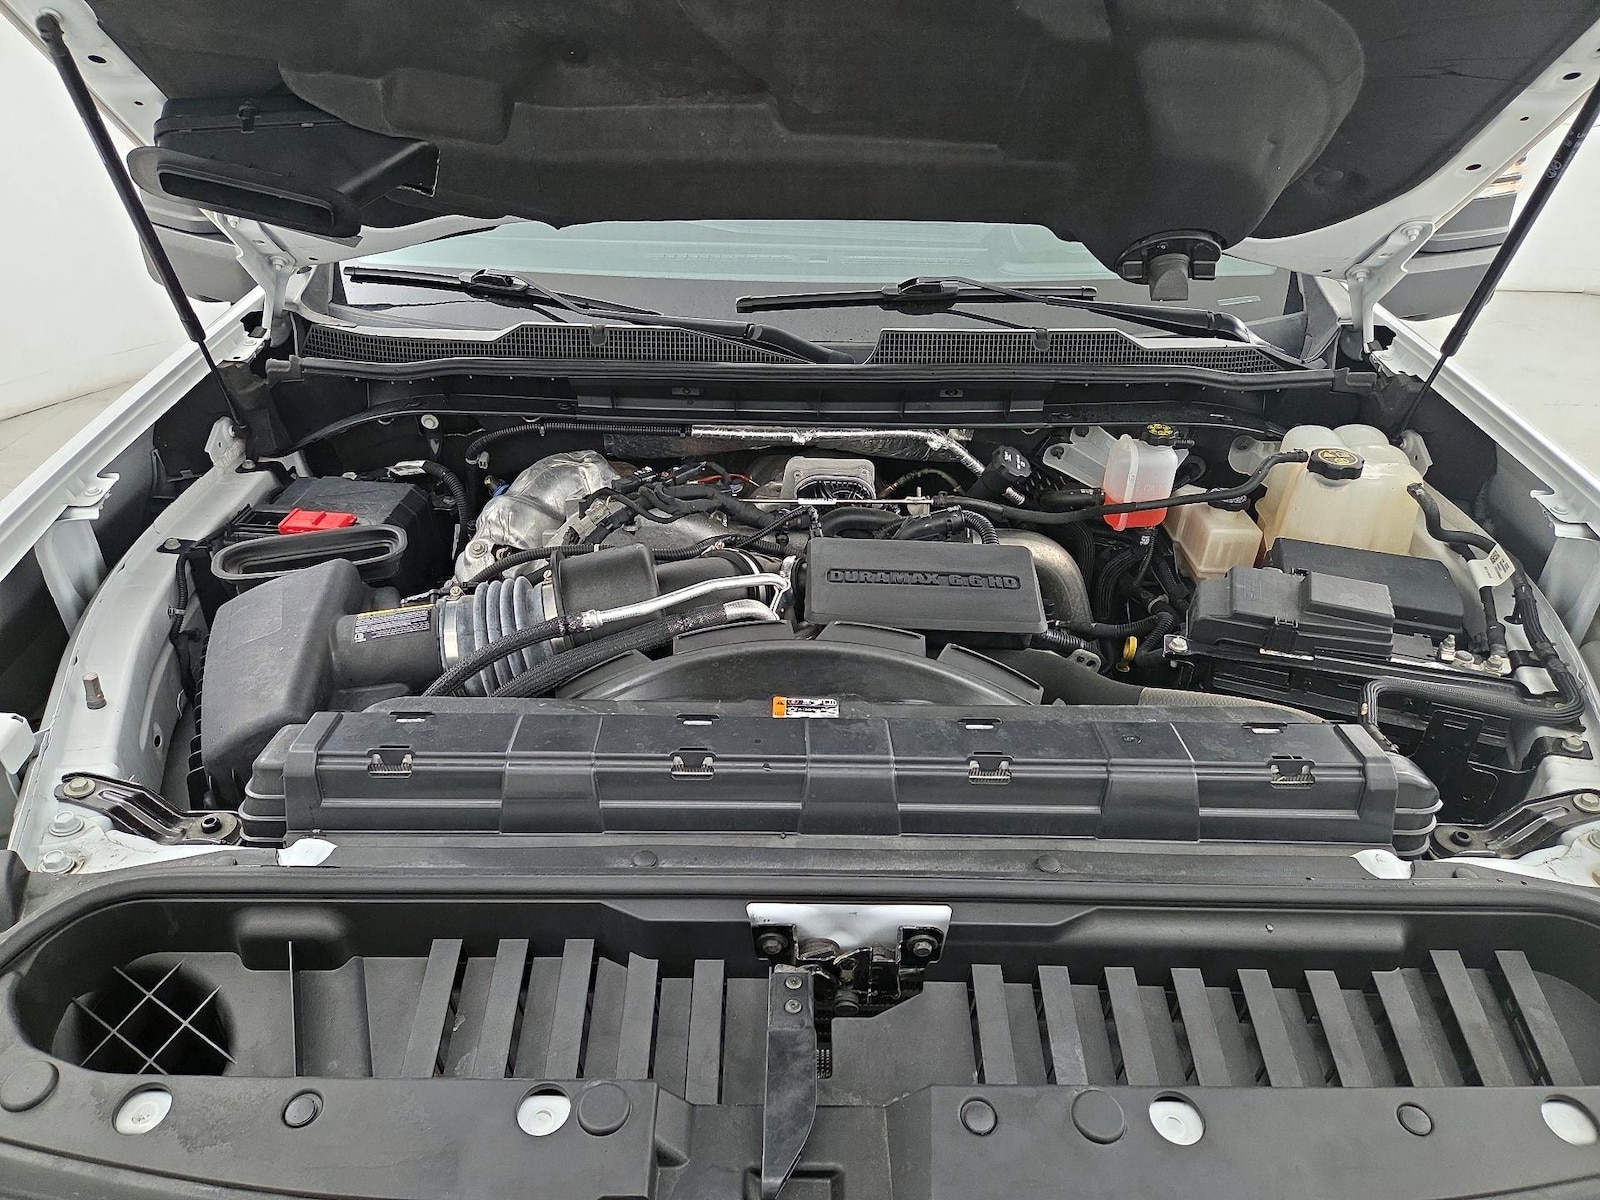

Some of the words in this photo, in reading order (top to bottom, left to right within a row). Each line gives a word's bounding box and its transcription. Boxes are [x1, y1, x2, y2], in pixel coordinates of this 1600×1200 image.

[828, 570, 940, 585] DURAMAX
[948, 574, 983, 587] 6.6
[987, 576, 1019, 589] HD
